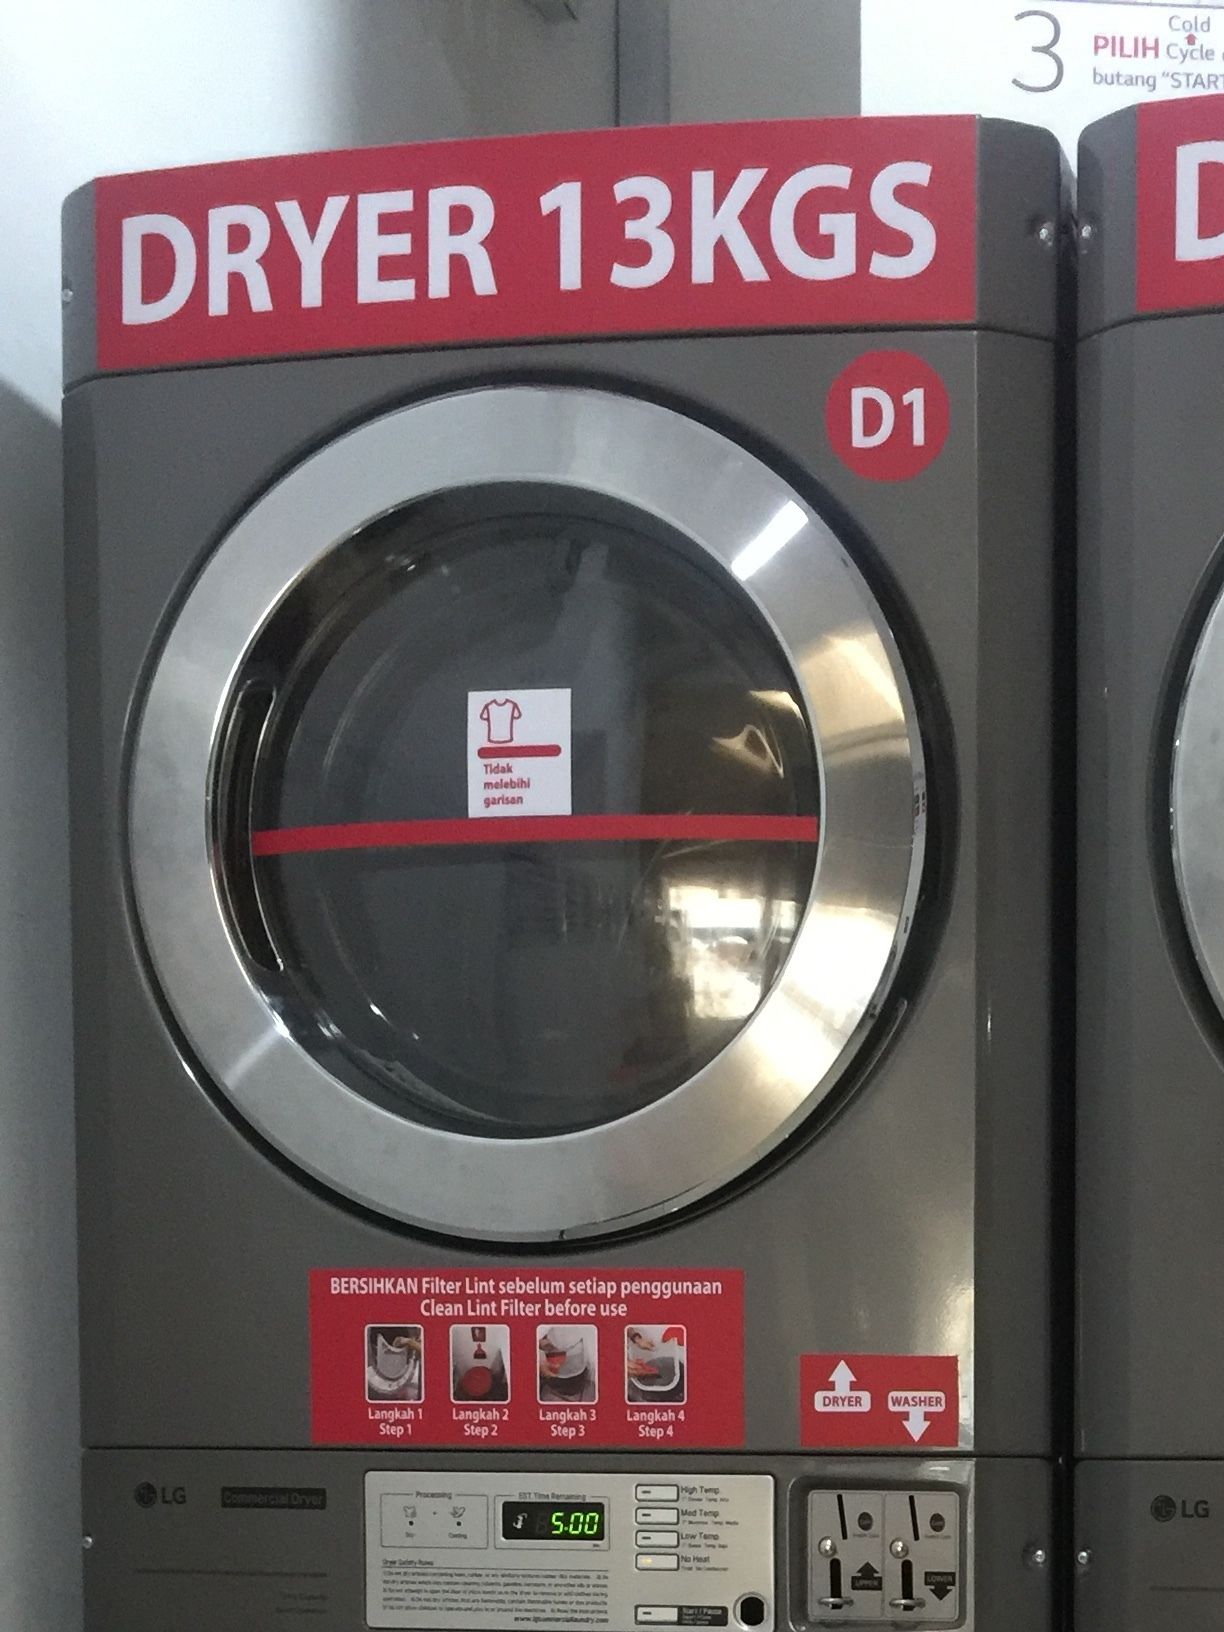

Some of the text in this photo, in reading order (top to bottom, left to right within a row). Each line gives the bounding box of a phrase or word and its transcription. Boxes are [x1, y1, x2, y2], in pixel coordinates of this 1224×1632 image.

[1169, 15, 1211, 33] Cold
[1012, 10, 1064, 92] 3
[1093, 35, 1160, 59] PILIH
[1166, 43, 1215, 64] Cycle
[1093, 67, 1156, 91] butang
[120, 161, 938, 325] DRYER 13KGS
[851, 386, 926, 449] D1
[484, 763, 513, 775] Tidak
[484, 778, 530, 790] melebihi
[484, 794, 523, 808] garisan
[330, 1277, 722, 1300] BERSIHKAN Filter Lint sebelum setiap penggunaan
[420, 1299, 628, 1318] Clean Lint Filter before use
[822, 1396, 862, 1407] DRYER
[891, 1396, 943, 1407] WASHER
[368, 1408, 424, 1422] Langkah 1
[452, 1408, 509, 1422] Langkah 2
[539, 1408, 597, 1422] Langkah 3
[627, 1408, 685, 1422] Langkah 4
[379, 1423, 413, 1437] Step 1
[464, 1424, 498, 1437] Step 2
[551, 1424, 586, 1437] Step 3
[638, 1424, 674, 1438] Step 4
[162, 1486, 187, 1505] LG
[1181, 1500, 1210, 1518] LG
[551, 1512, 599, 1534] 5.00
